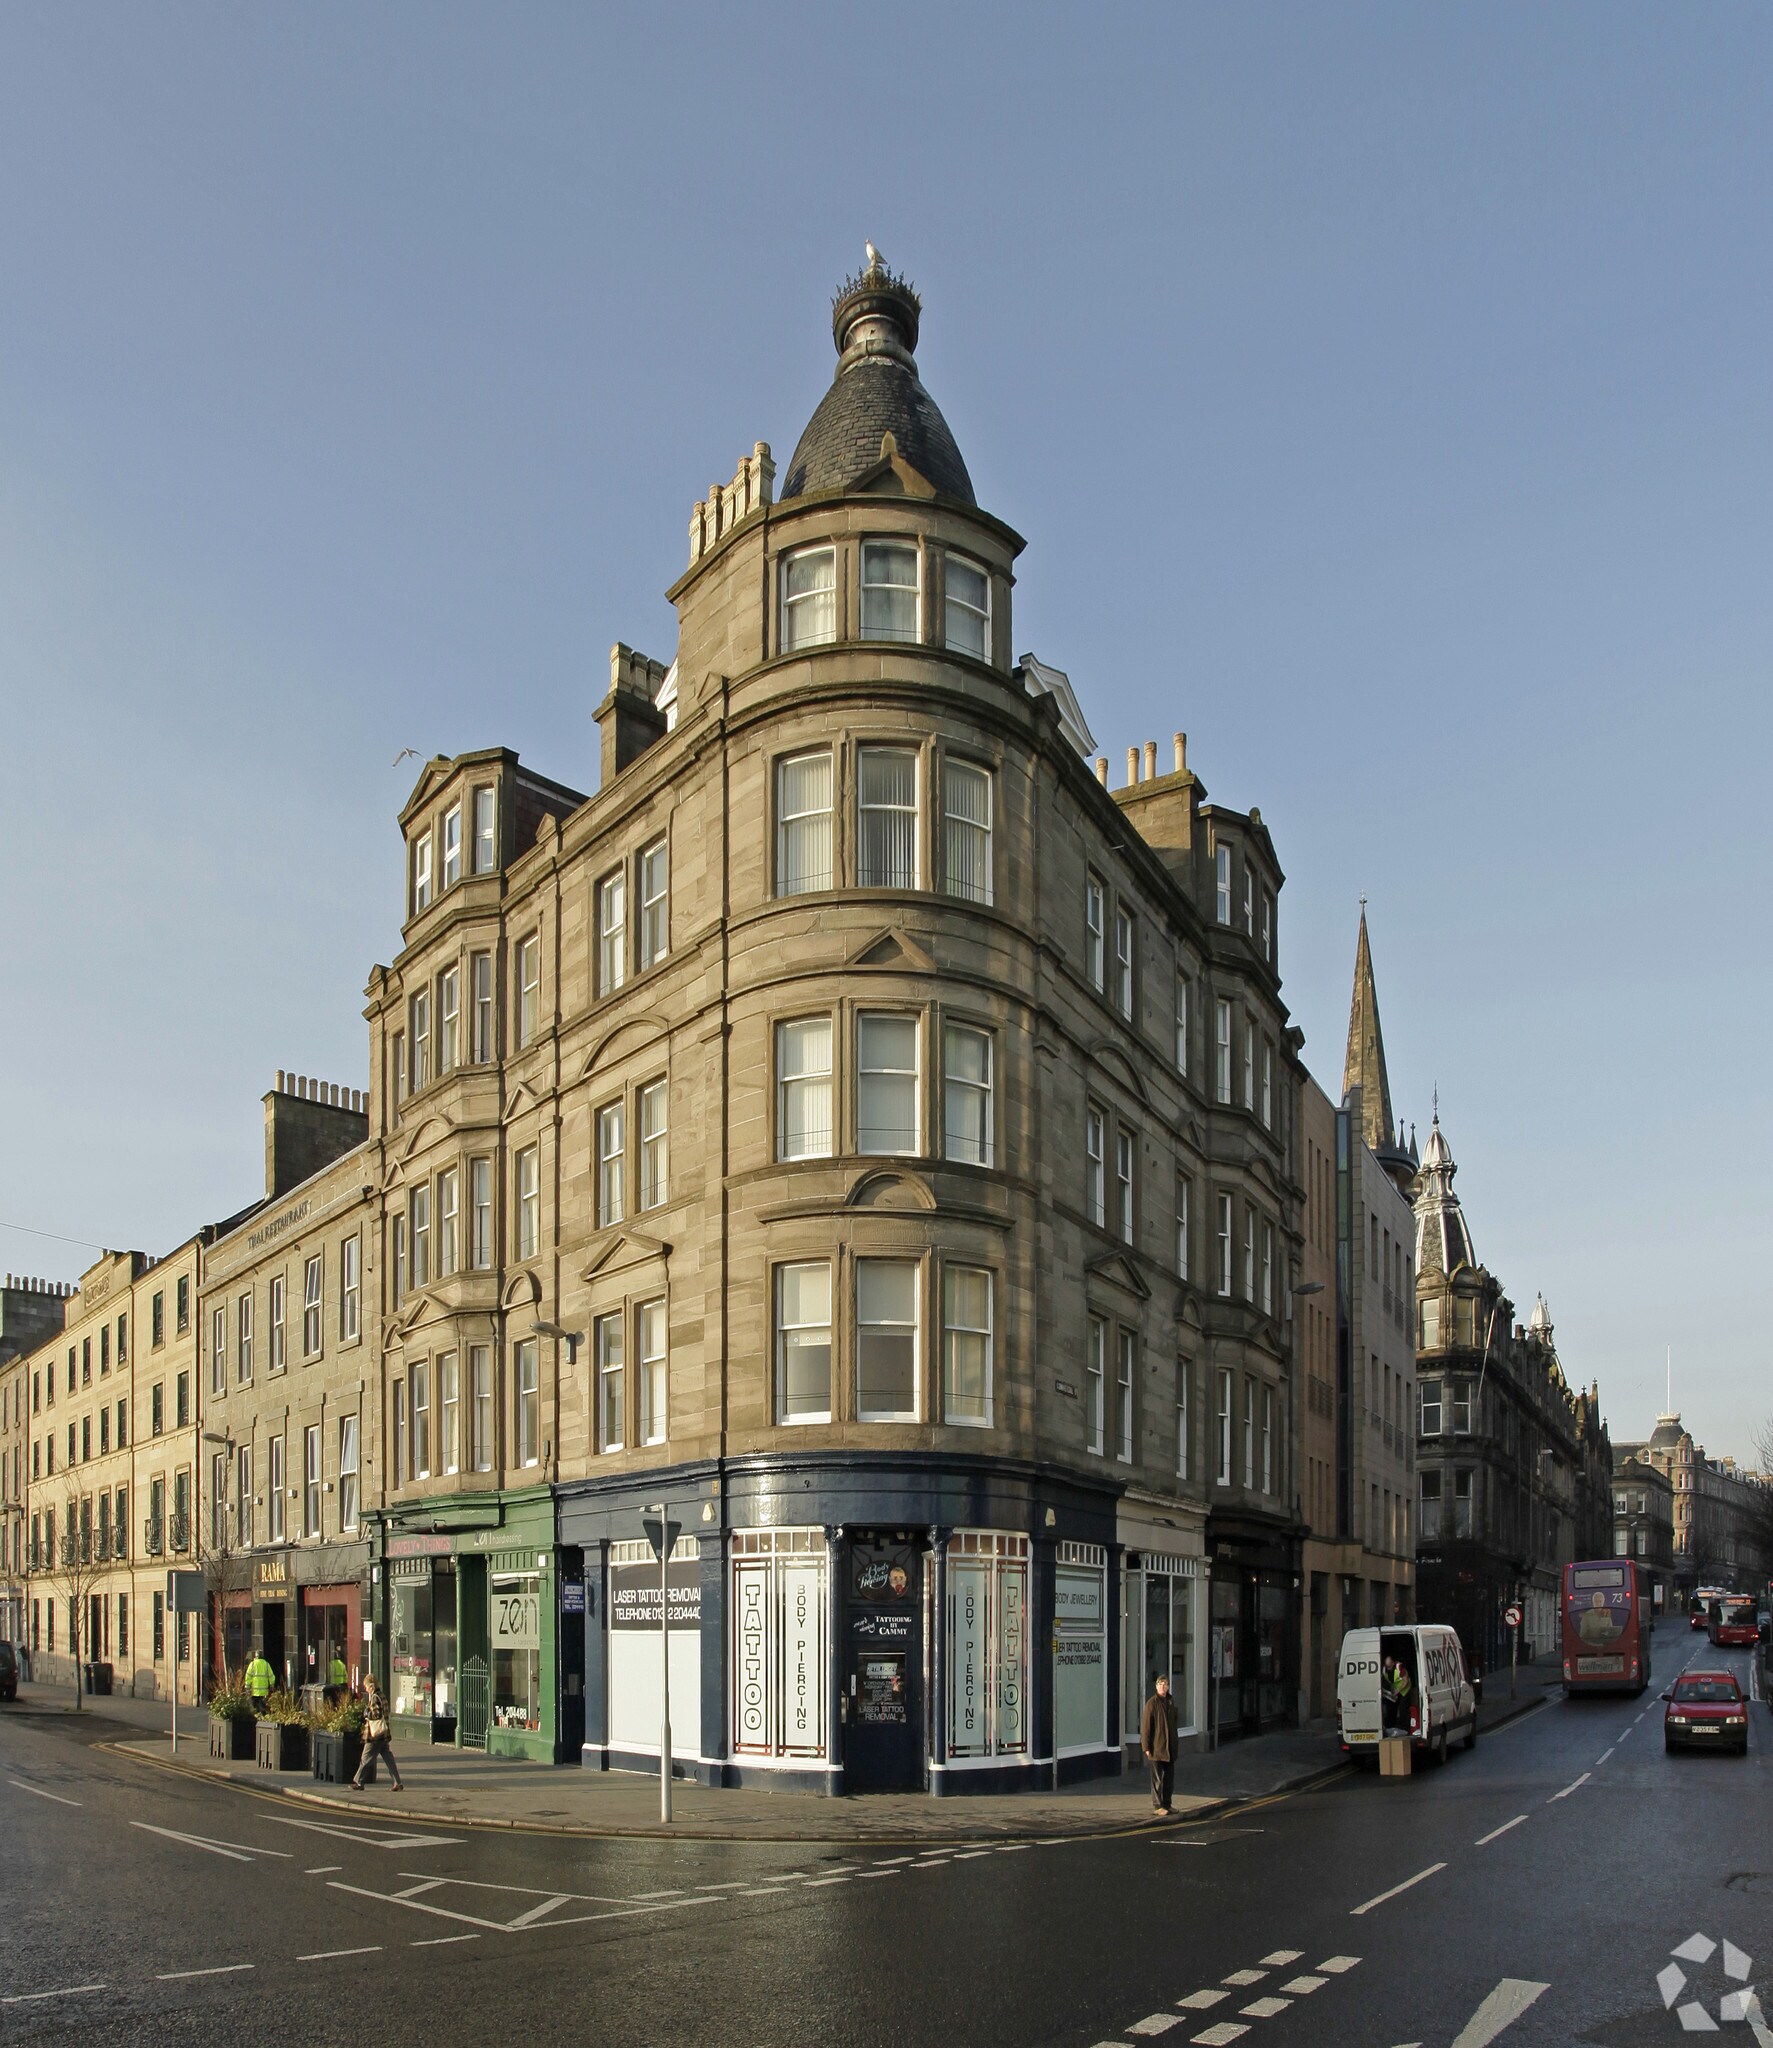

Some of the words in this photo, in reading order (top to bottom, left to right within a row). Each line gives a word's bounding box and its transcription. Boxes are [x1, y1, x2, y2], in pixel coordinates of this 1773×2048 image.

[265, 1200, 312, 1241] RESTAURANT
[421, 1535, 450, 1553] THINGS
[261, 1562, 286, 1582] RAMA
[613, 1589, 636, 1604] LASER
[1070, 1593, 1098, 1605] JEWELLERY
[1612, 1593, 1623, 1603] 73
[615, 1607, 652, 1620] TELEPHONE
[797, 1584, 806, 1629] BODY
[965, 1586, 975, 1629] BODY
[498, 1598, 538, 1635] zen
[875, 1615, 912, 1623] TATTOOING
[879, 1627, 908, 1635] CAMMY
[744, 1584, 762, 1730] TATTOO
[1004, 1586, 1019, 1731] TATTOO
[1347, 1661, 1379, 1676] DPD
[1425, 1649, 1446, 1687] DPD
[796, 1640, 807, 1730] PIERCING
[965, 1641, 975, 1730] PIERCING
[859, 1705, 880, 1713] LASER
[881, 1705, 905, 1713] TATTOO
[864, 1713, 899, 1721] REMOVAL
